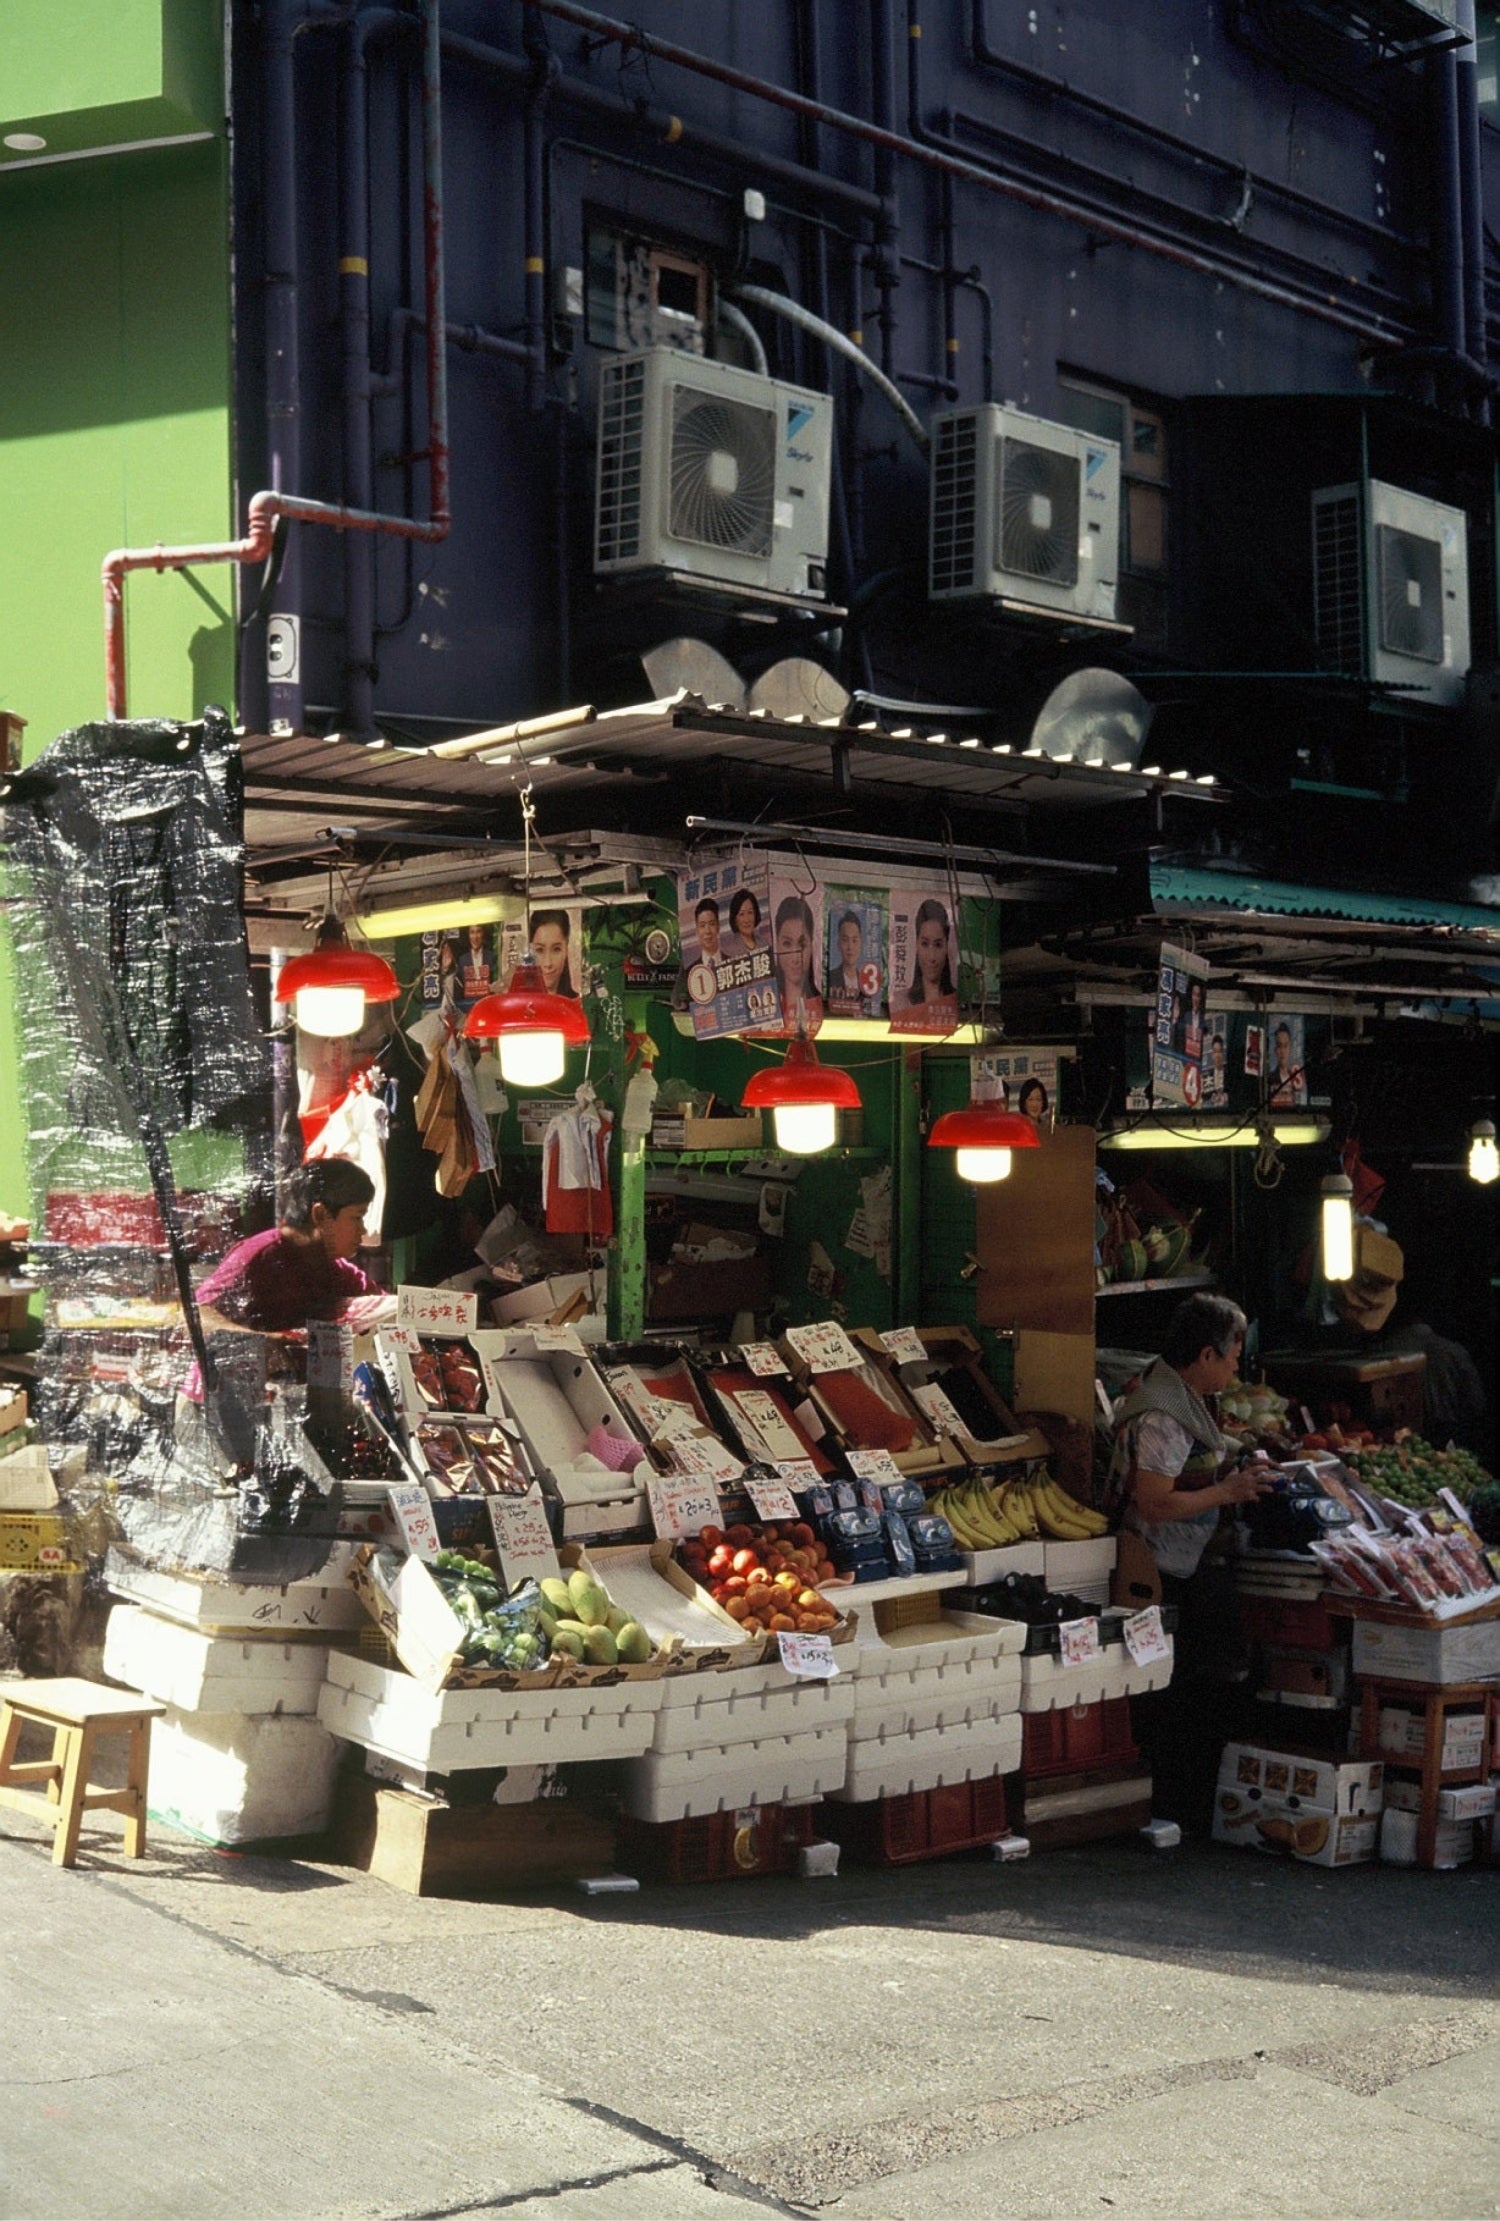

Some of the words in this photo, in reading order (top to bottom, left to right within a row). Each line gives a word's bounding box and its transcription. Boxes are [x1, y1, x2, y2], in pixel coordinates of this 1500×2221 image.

[685, 865, 737, 902] 新民黨
[696, 973, 707, 996] 1
[715, 952, 772, 991] 郭杰駿
[862, 963, 879, 996] 3
[1185, 1066, 1198, 1102] 4
